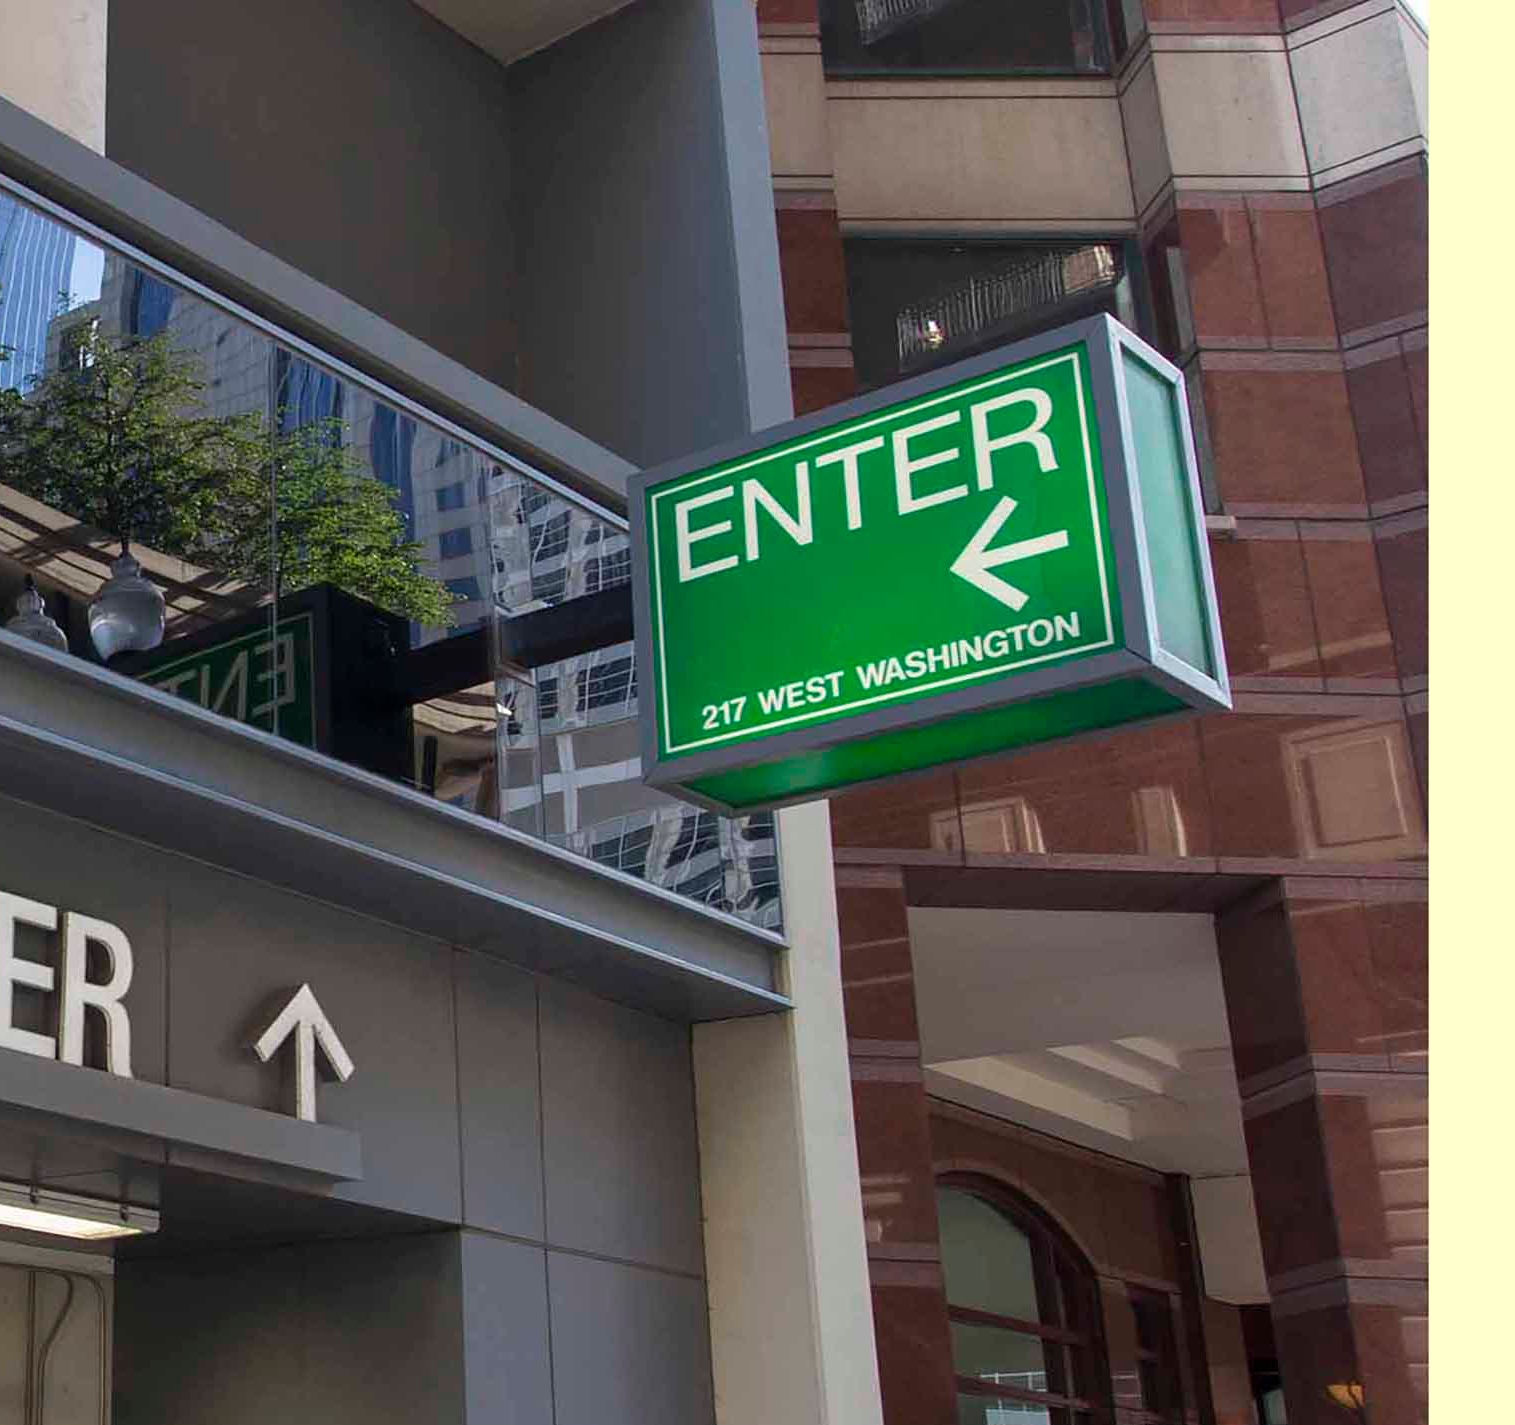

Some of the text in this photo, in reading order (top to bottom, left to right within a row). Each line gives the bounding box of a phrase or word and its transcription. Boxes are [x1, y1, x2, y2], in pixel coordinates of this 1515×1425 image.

[674, 387, 1059, 583] ENTER
[702, 612, 1081, 731] 217 WEST WASHINGTON
